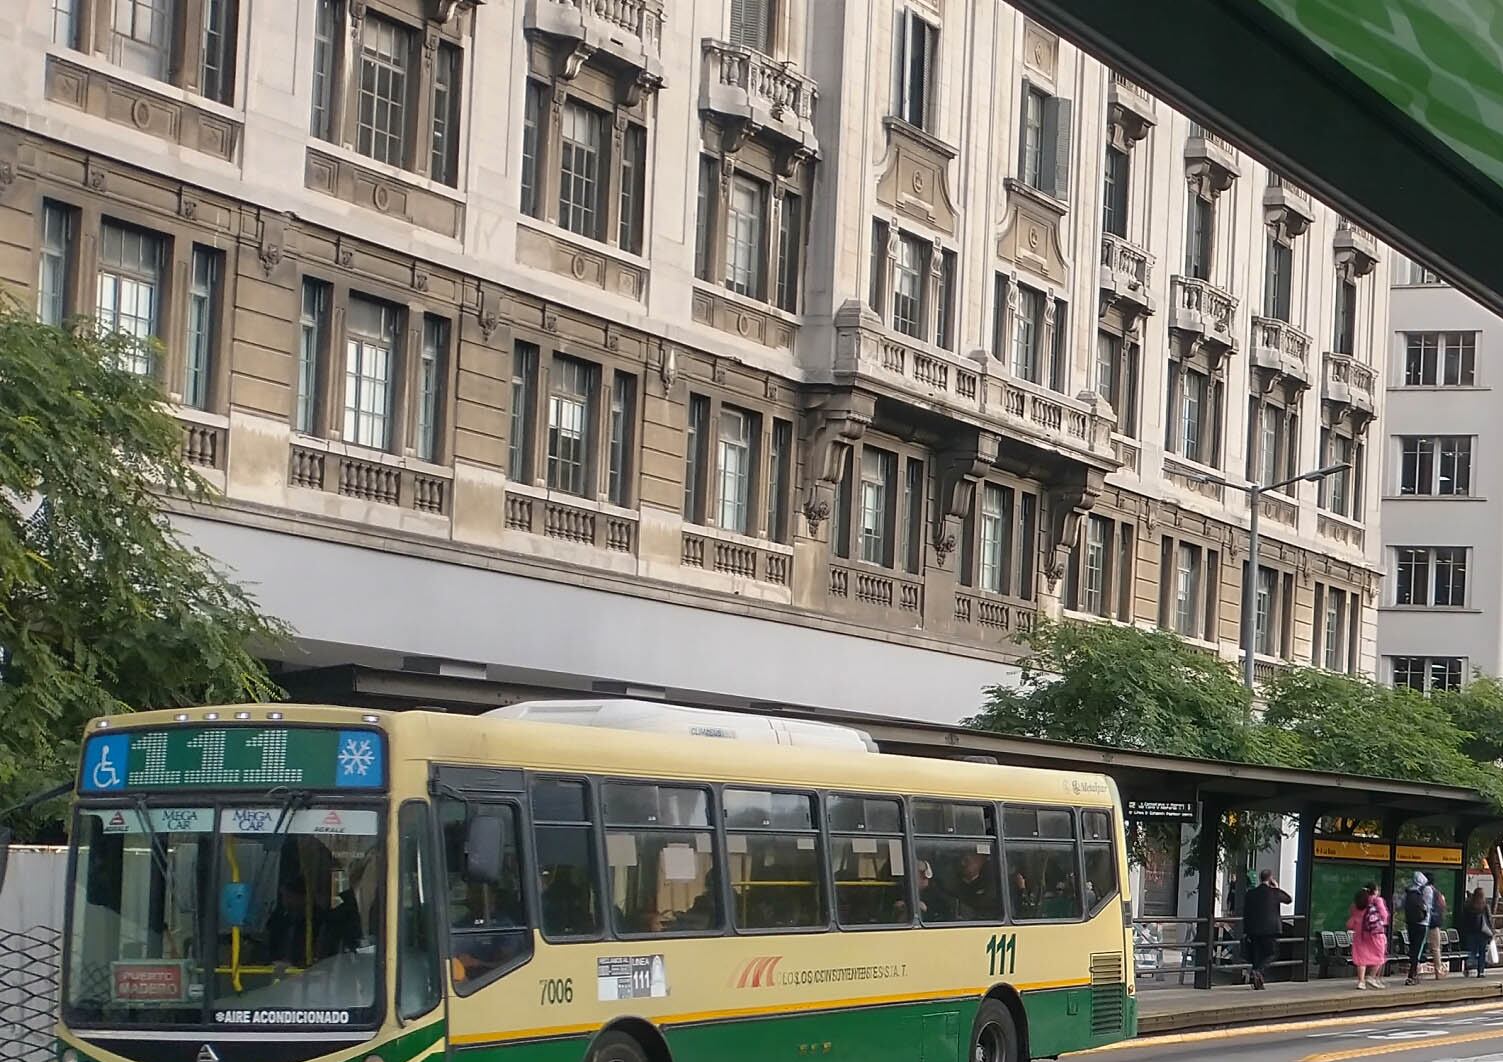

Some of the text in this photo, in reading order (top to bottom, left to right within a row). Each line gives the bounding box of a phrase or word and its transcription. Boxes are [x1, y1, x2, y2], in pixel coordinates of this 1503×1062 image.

[128, 730, 303, 785] 111
[161, 809, 198, 821] MEGA
[232, 809, 272, 821] MEGA
[167, 820, 191, 830] CAR
[238, 819, 265, 831] CAR
[987, 933, 1016, 976] 111
[633, 970, 650, 989] 111
[539, 977, 573, 1005] 7006
[224, 1010, 349, 1024] AIRE ACONDICIONADO
